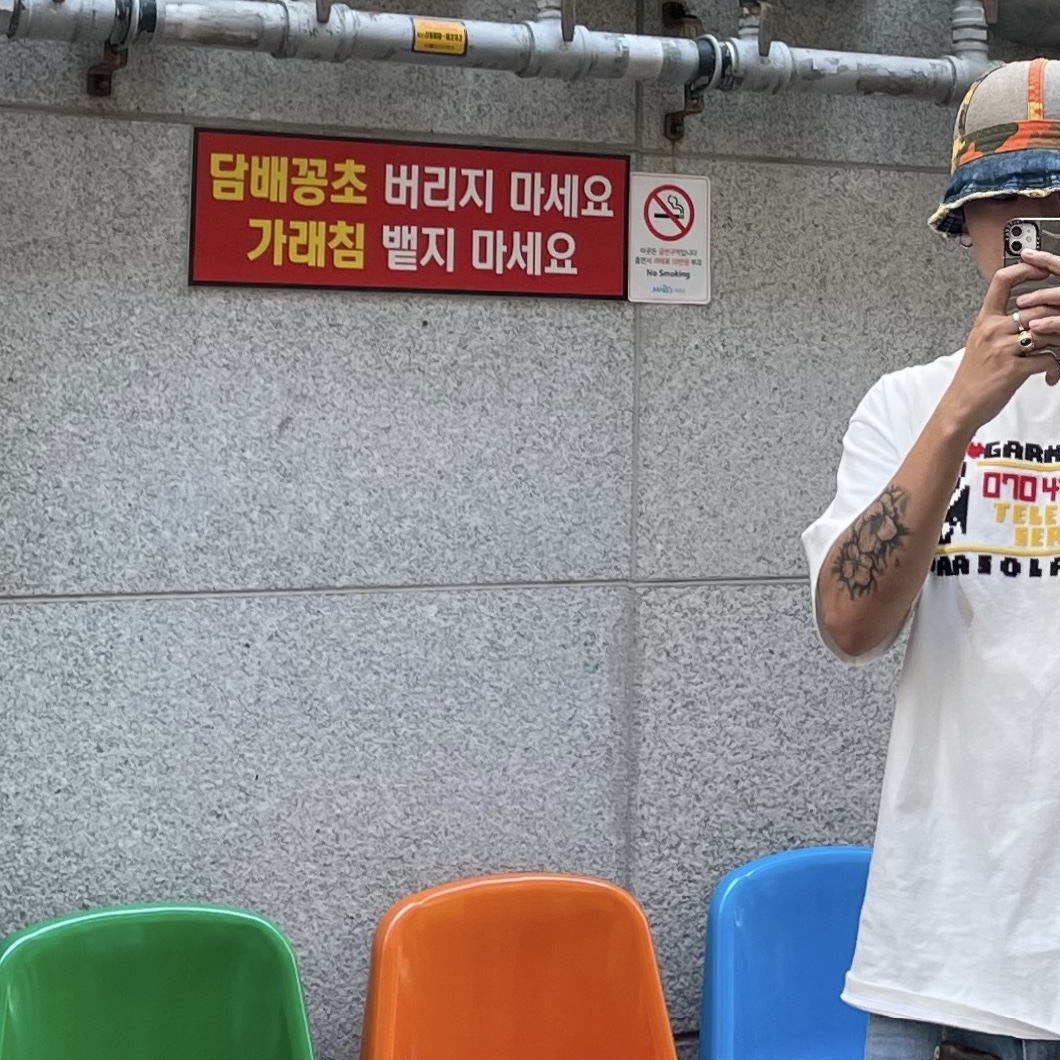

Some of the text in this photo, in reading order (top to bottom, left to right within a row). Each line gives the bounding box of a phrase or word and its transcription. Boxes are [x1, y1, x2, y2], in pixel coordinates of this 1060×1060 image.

[210, 152, 615, 219] 담배꽁초 버리지 마세요
[246, 217, 578, 277] 가래침 뱉지 마세요
[646, 268, 691, 280] No Smoking
[982, 472, 1037, 503] 070
